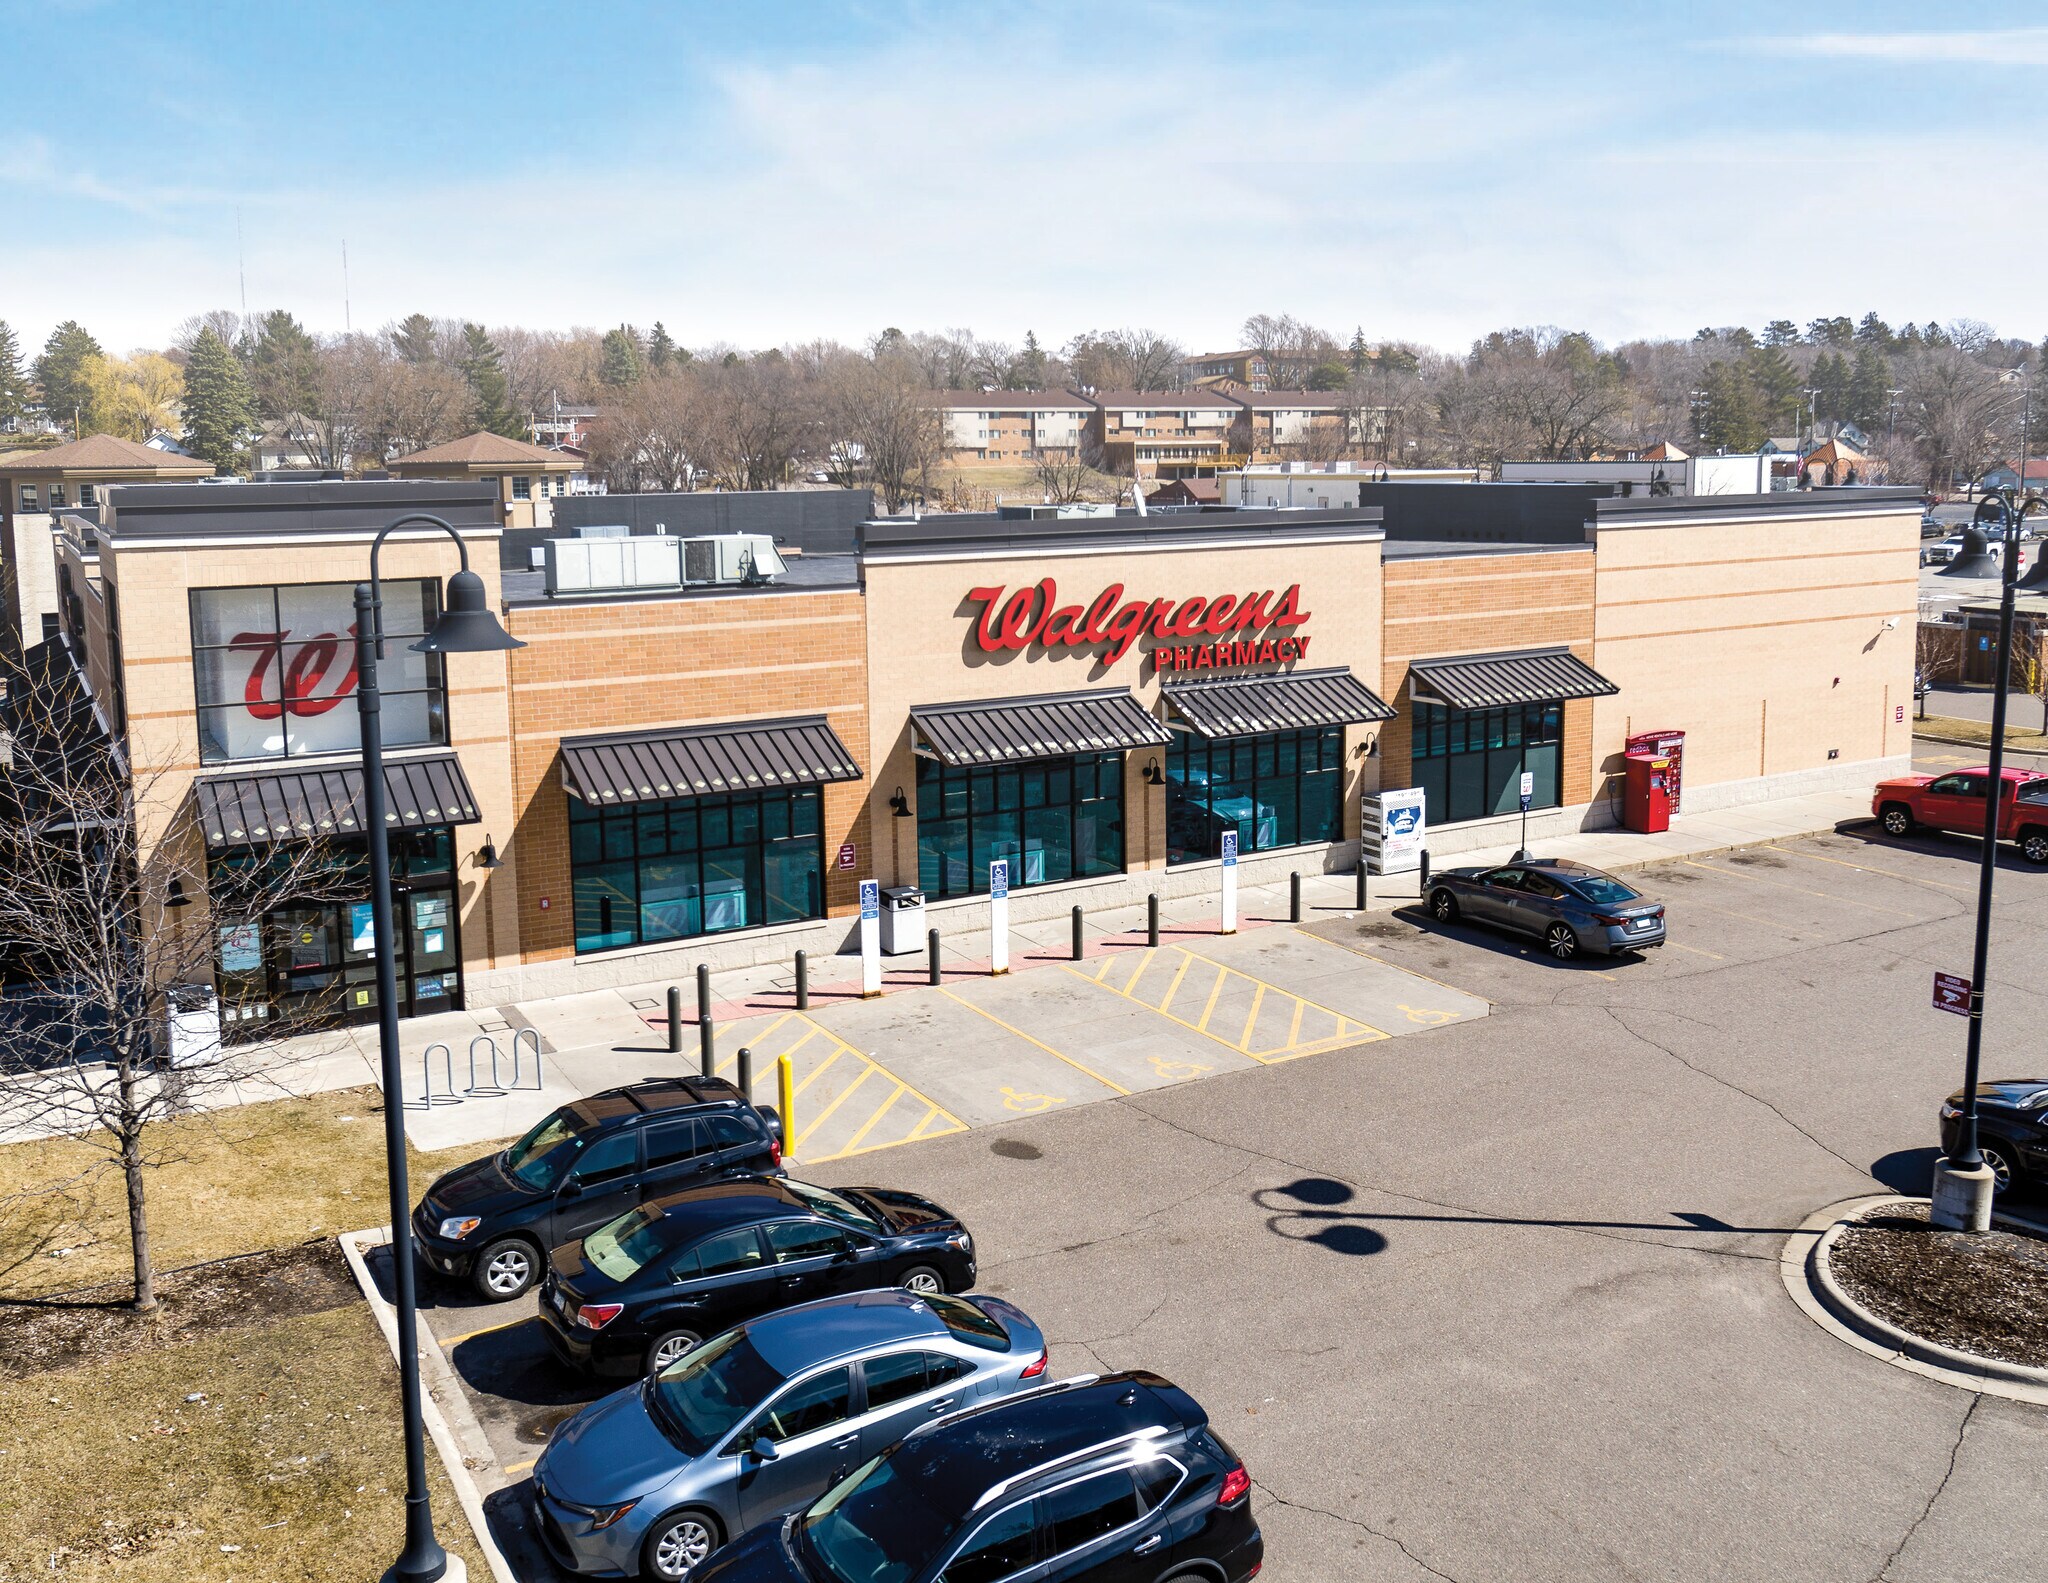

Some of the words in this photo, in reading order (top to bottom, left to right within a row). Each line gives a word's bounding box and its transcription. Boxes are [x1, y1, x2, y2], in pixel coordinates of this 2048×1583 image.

[969, 577, 1312, 667] Walgreens
[228, 622, 358, 720] W
[1152, 636, 1311, 673] PHARMACY
[1629, 745, 1650, 754] redbox
